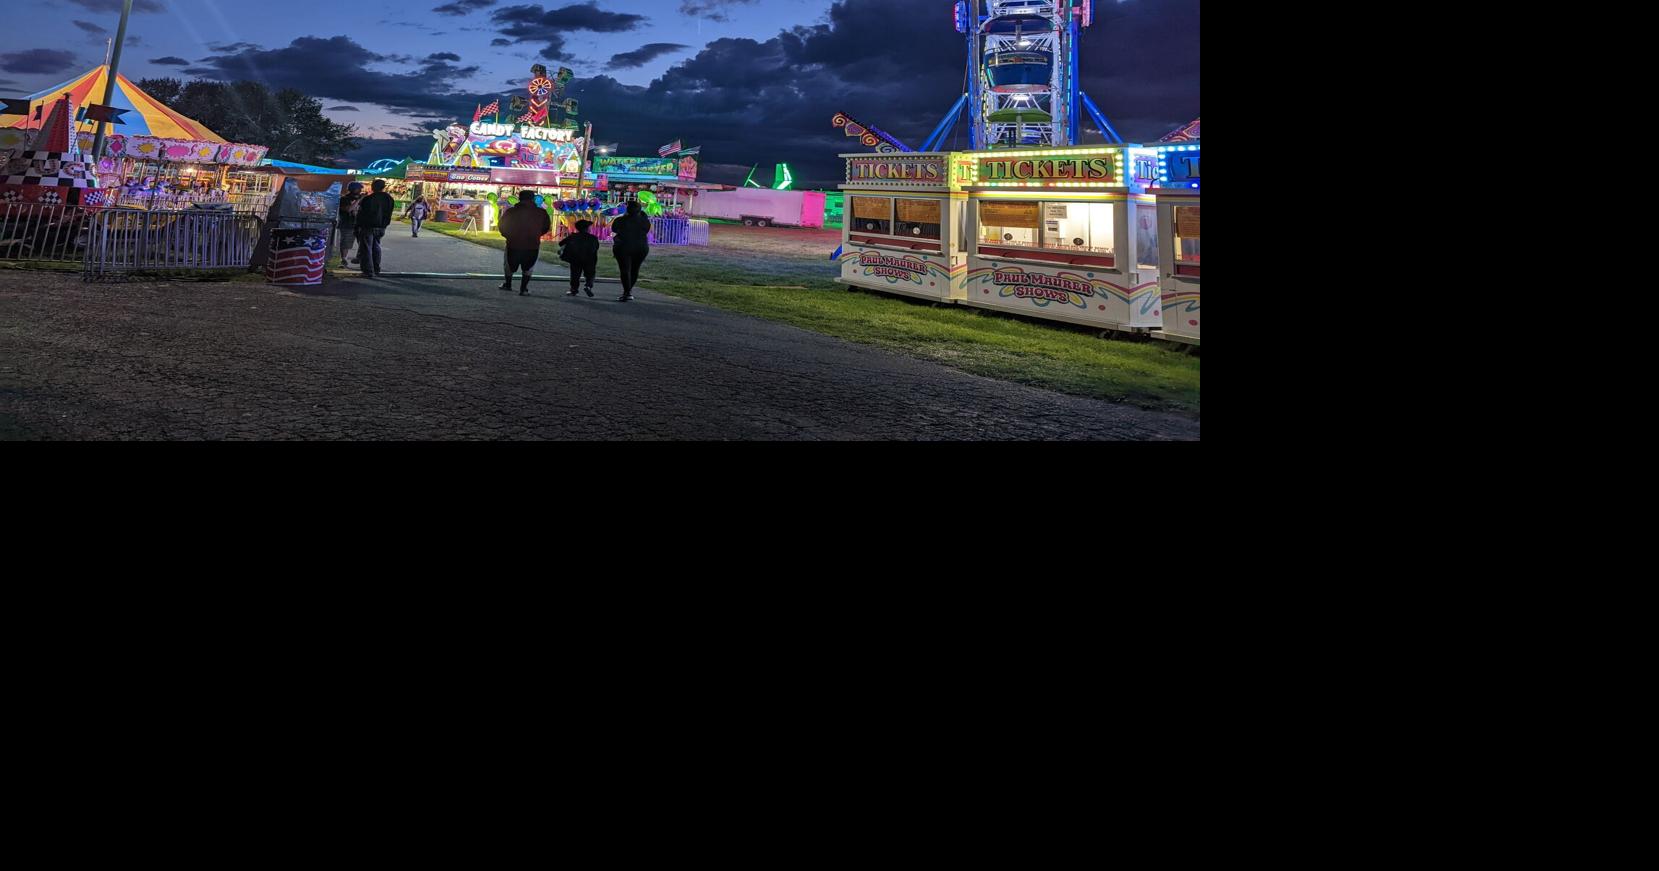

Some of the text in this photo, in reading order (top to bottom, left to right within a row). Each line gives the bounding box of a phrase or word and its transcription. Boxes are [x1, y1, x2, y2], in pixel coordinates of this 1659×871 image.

[470, 122, 574, 142] CANDY FACTORY
[599, 157, 637, 166] WATER
[857, 162, 938, 179] TICKETS
[986, 157, 1108, 180] TICKETS
[860, 255, 927, 274] PAUL MAURER
[875, 266, 911, 280] SHOWS
[994, 271, 1093, 295] PAUL MAURER
[1015, 285, 1068, 303] SHOWS
